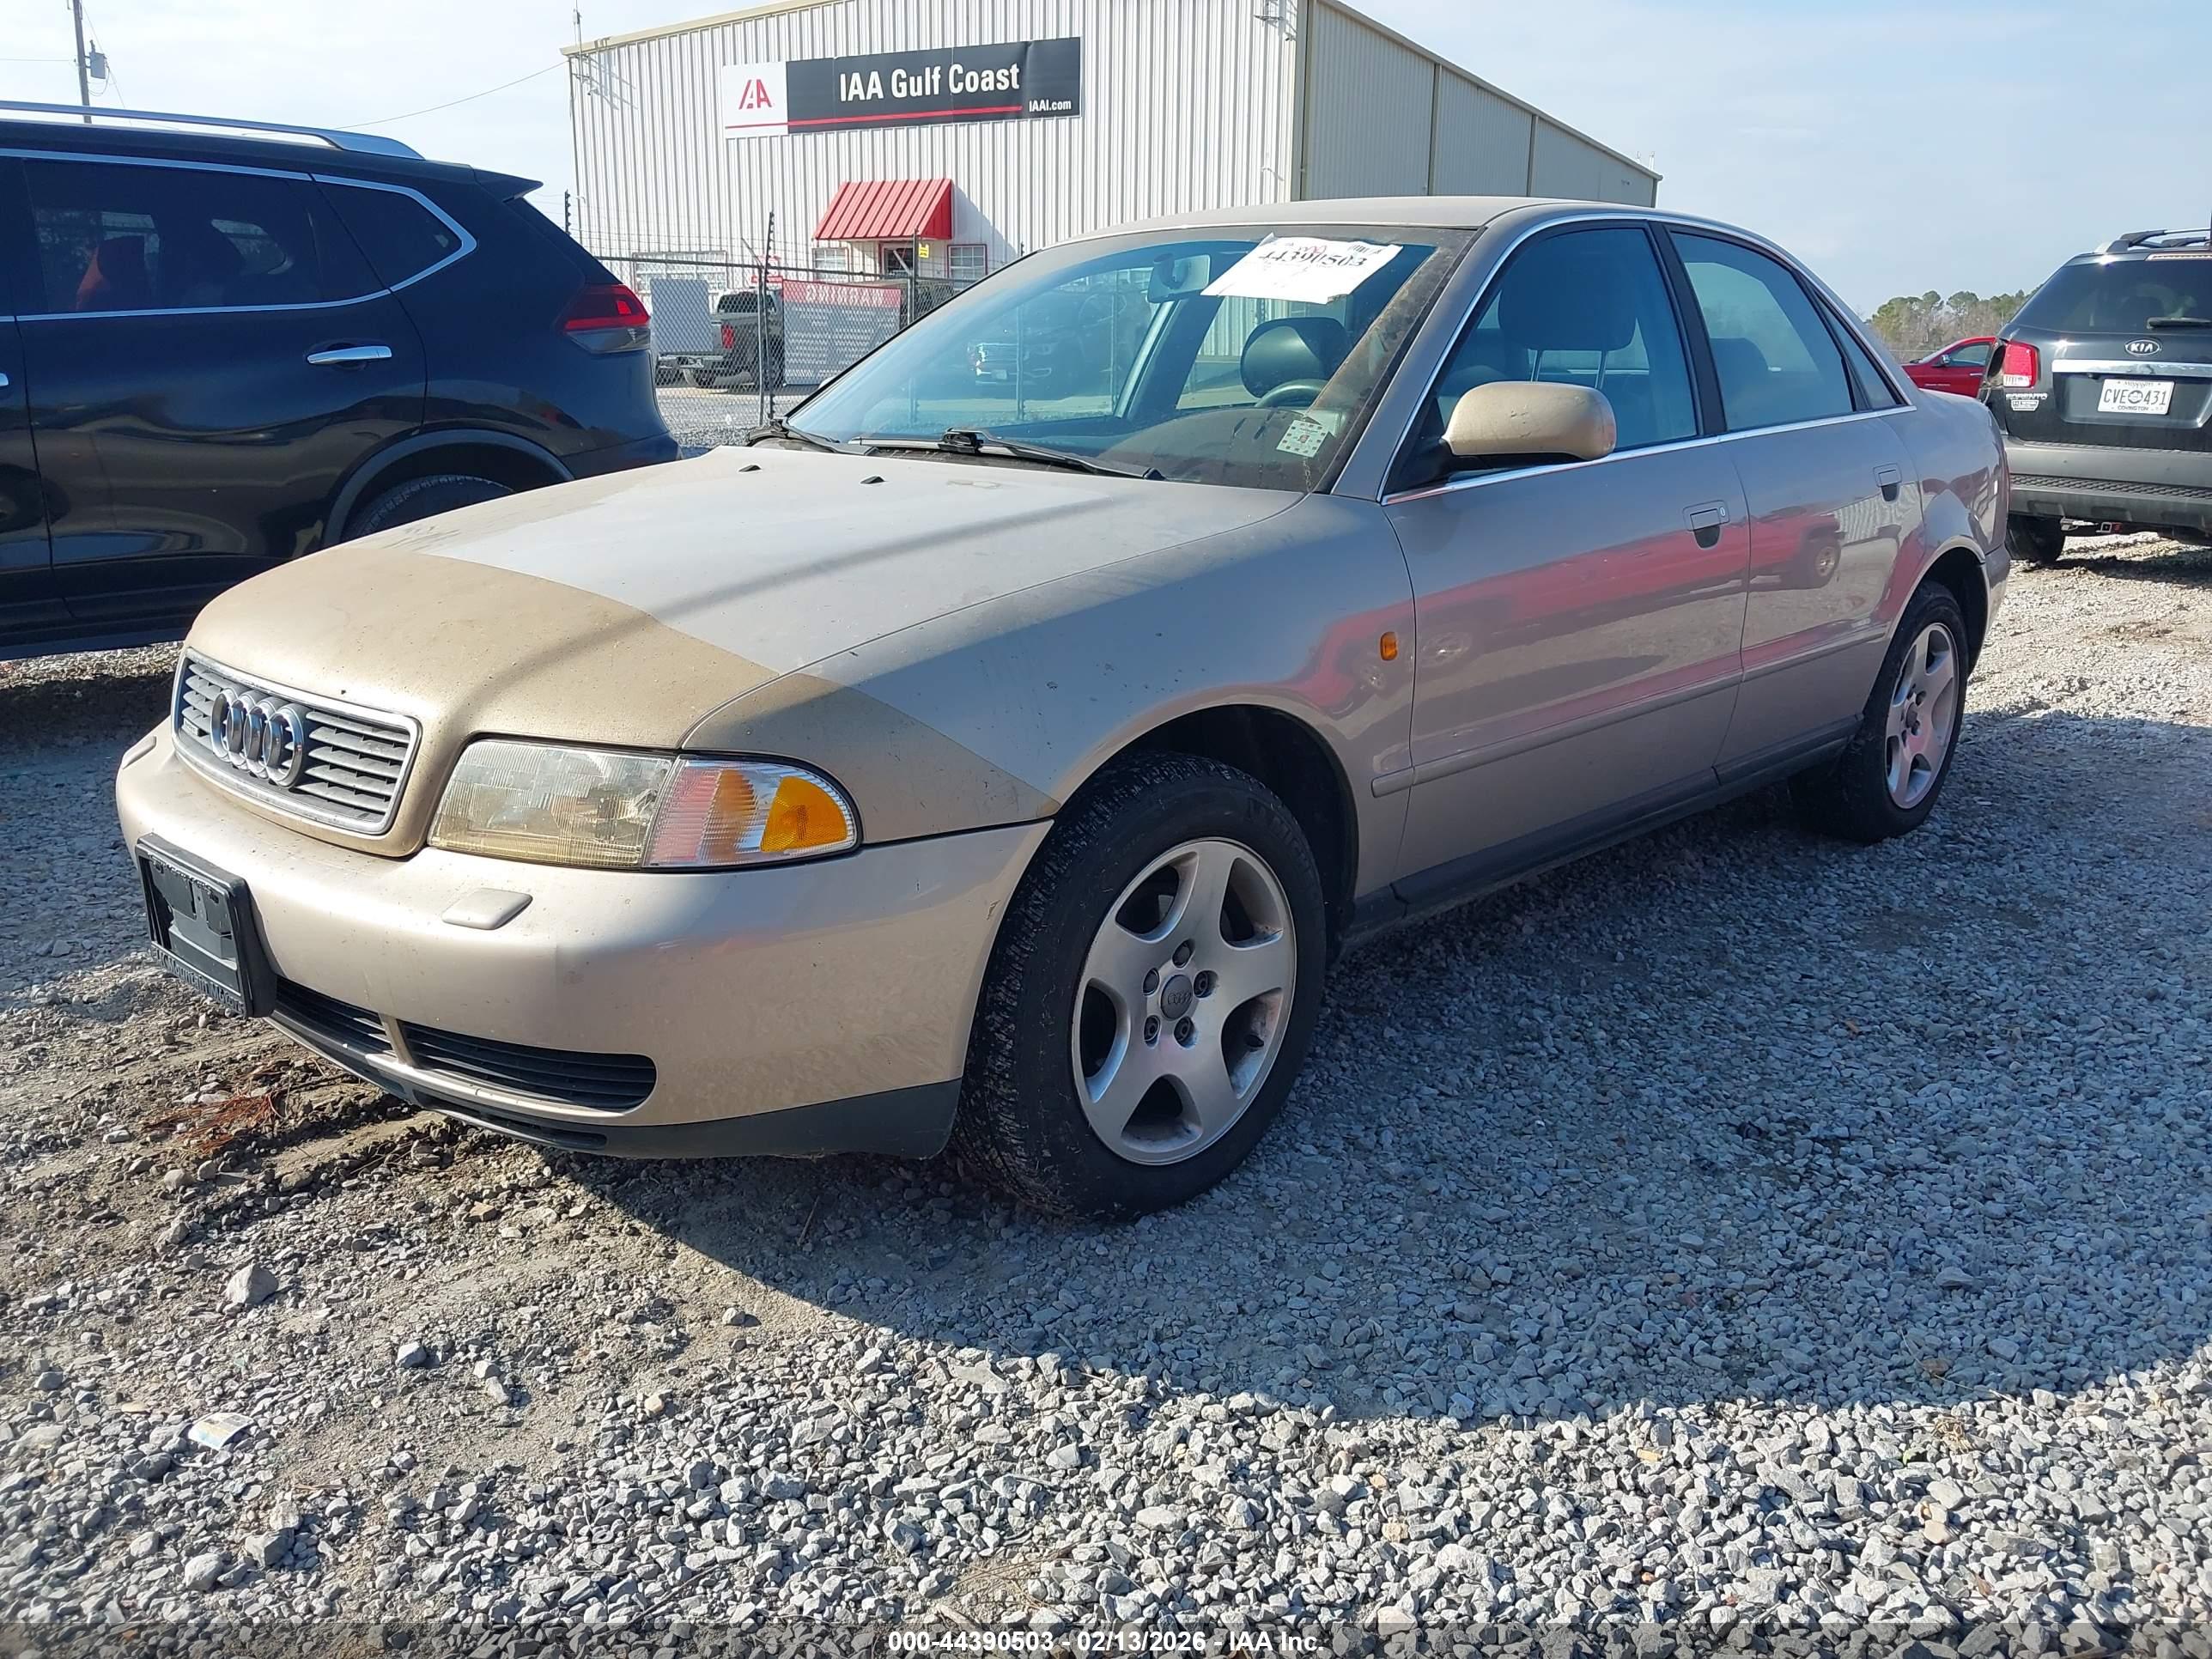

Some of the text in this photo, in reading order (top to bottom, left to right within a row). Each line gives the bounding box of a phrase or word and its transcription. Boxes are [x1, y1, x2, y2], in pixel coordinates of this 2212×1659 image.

[840, 63, 1020, 101] IAA Gulf Coast
[2130, 343, 2153, 353] KIA
[2103, 388, 2166, 405] CVE 431
